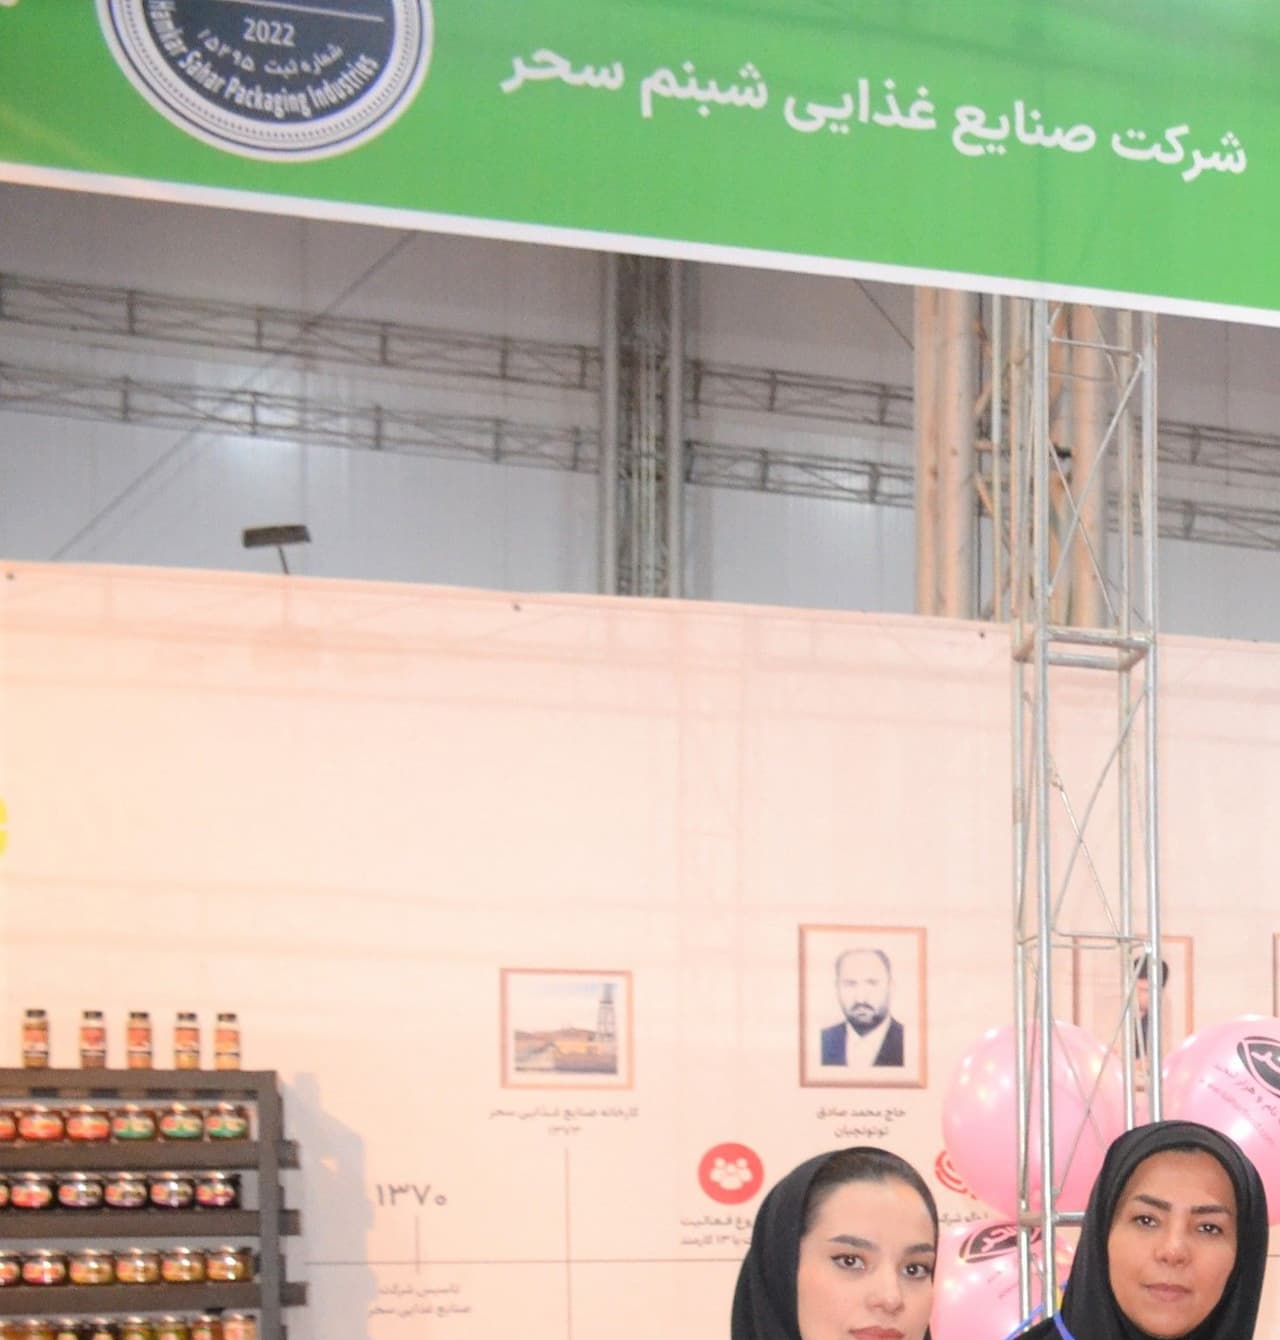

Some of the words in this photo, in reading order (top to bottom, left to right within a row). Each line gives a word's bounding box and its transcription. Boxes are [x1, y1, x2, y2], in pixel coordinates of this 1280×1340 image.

[243, 18, 296, 47] 2022
[177, 50, 227, 93] Sahar
[223, 77, 313, 120] Packaging
[306, 53, 381, 109] Industries
[500, 47, 626, 94] سحر
[639, 60, 770, 119] شبنم
[783, 77, 938, 136] غذایی
[951, 100, 1098, 157] صنایع
[1110, 124, 1249, 183] شرکت
[375, 1183, 448, 1208] ۱۳۷۰
